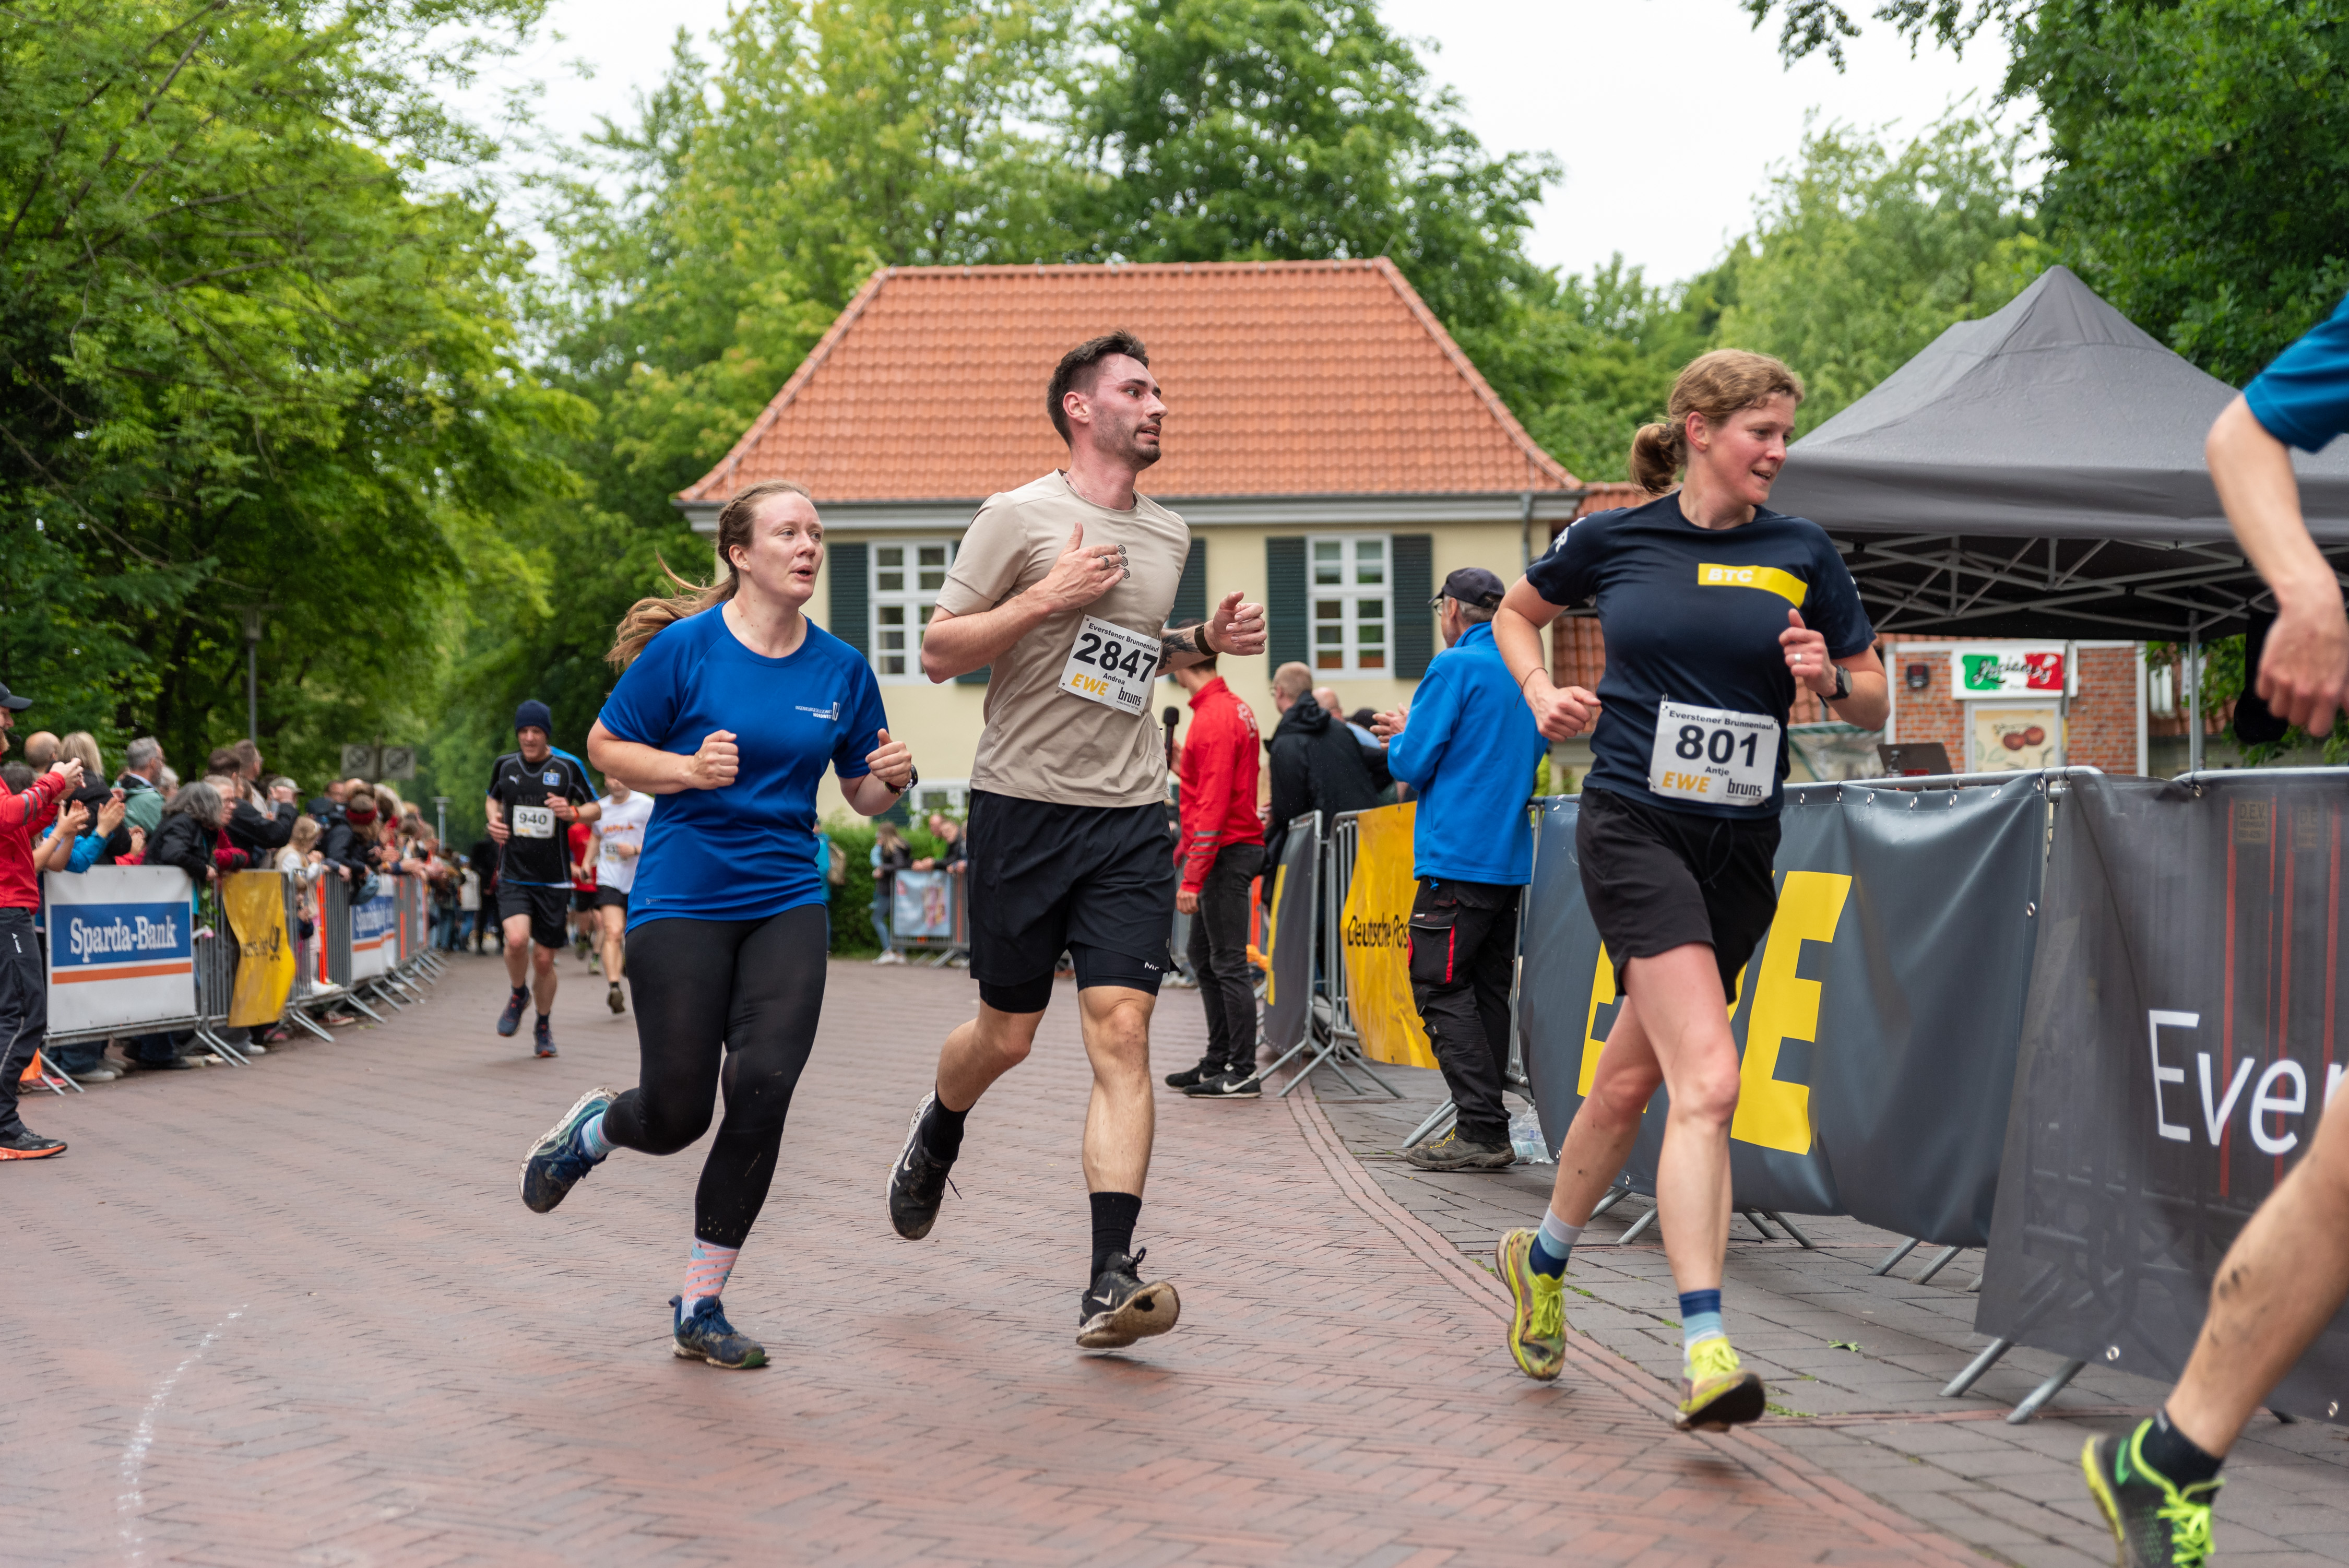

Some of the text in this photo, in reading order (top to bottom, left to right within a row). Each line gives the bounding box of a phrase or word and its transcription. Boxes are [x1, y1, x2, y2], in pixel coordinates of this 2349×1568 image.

[1707, 568, 1753, 582] BTC
[1088, 623, 1159, 652] Everstener Brunnenlauf
[1073, 633, 1158, 683] 2847
[1071, 673, 1109, 696] EWE
[1102, 673, 1125, 685] Andrea
[1118, 687, 1142, 706] bruns
[795, 705, 832, 714] INGENIEURGESELLSCHAFT
[1669, 710, 1774, 730] Everstener Brunnenlauf
[1676, 724, 1758, 767] 801
[1704, 766, 1730, 776] Antje
[1662, 771, 1711, 793] EWE
[1727, 778, 1762, 797] bruns
[519, 812, 547, 825] 940
[70, 914, 179, 964] Sparda-Bank
[1347, 912, 1408, 949] Deutsche Pos
